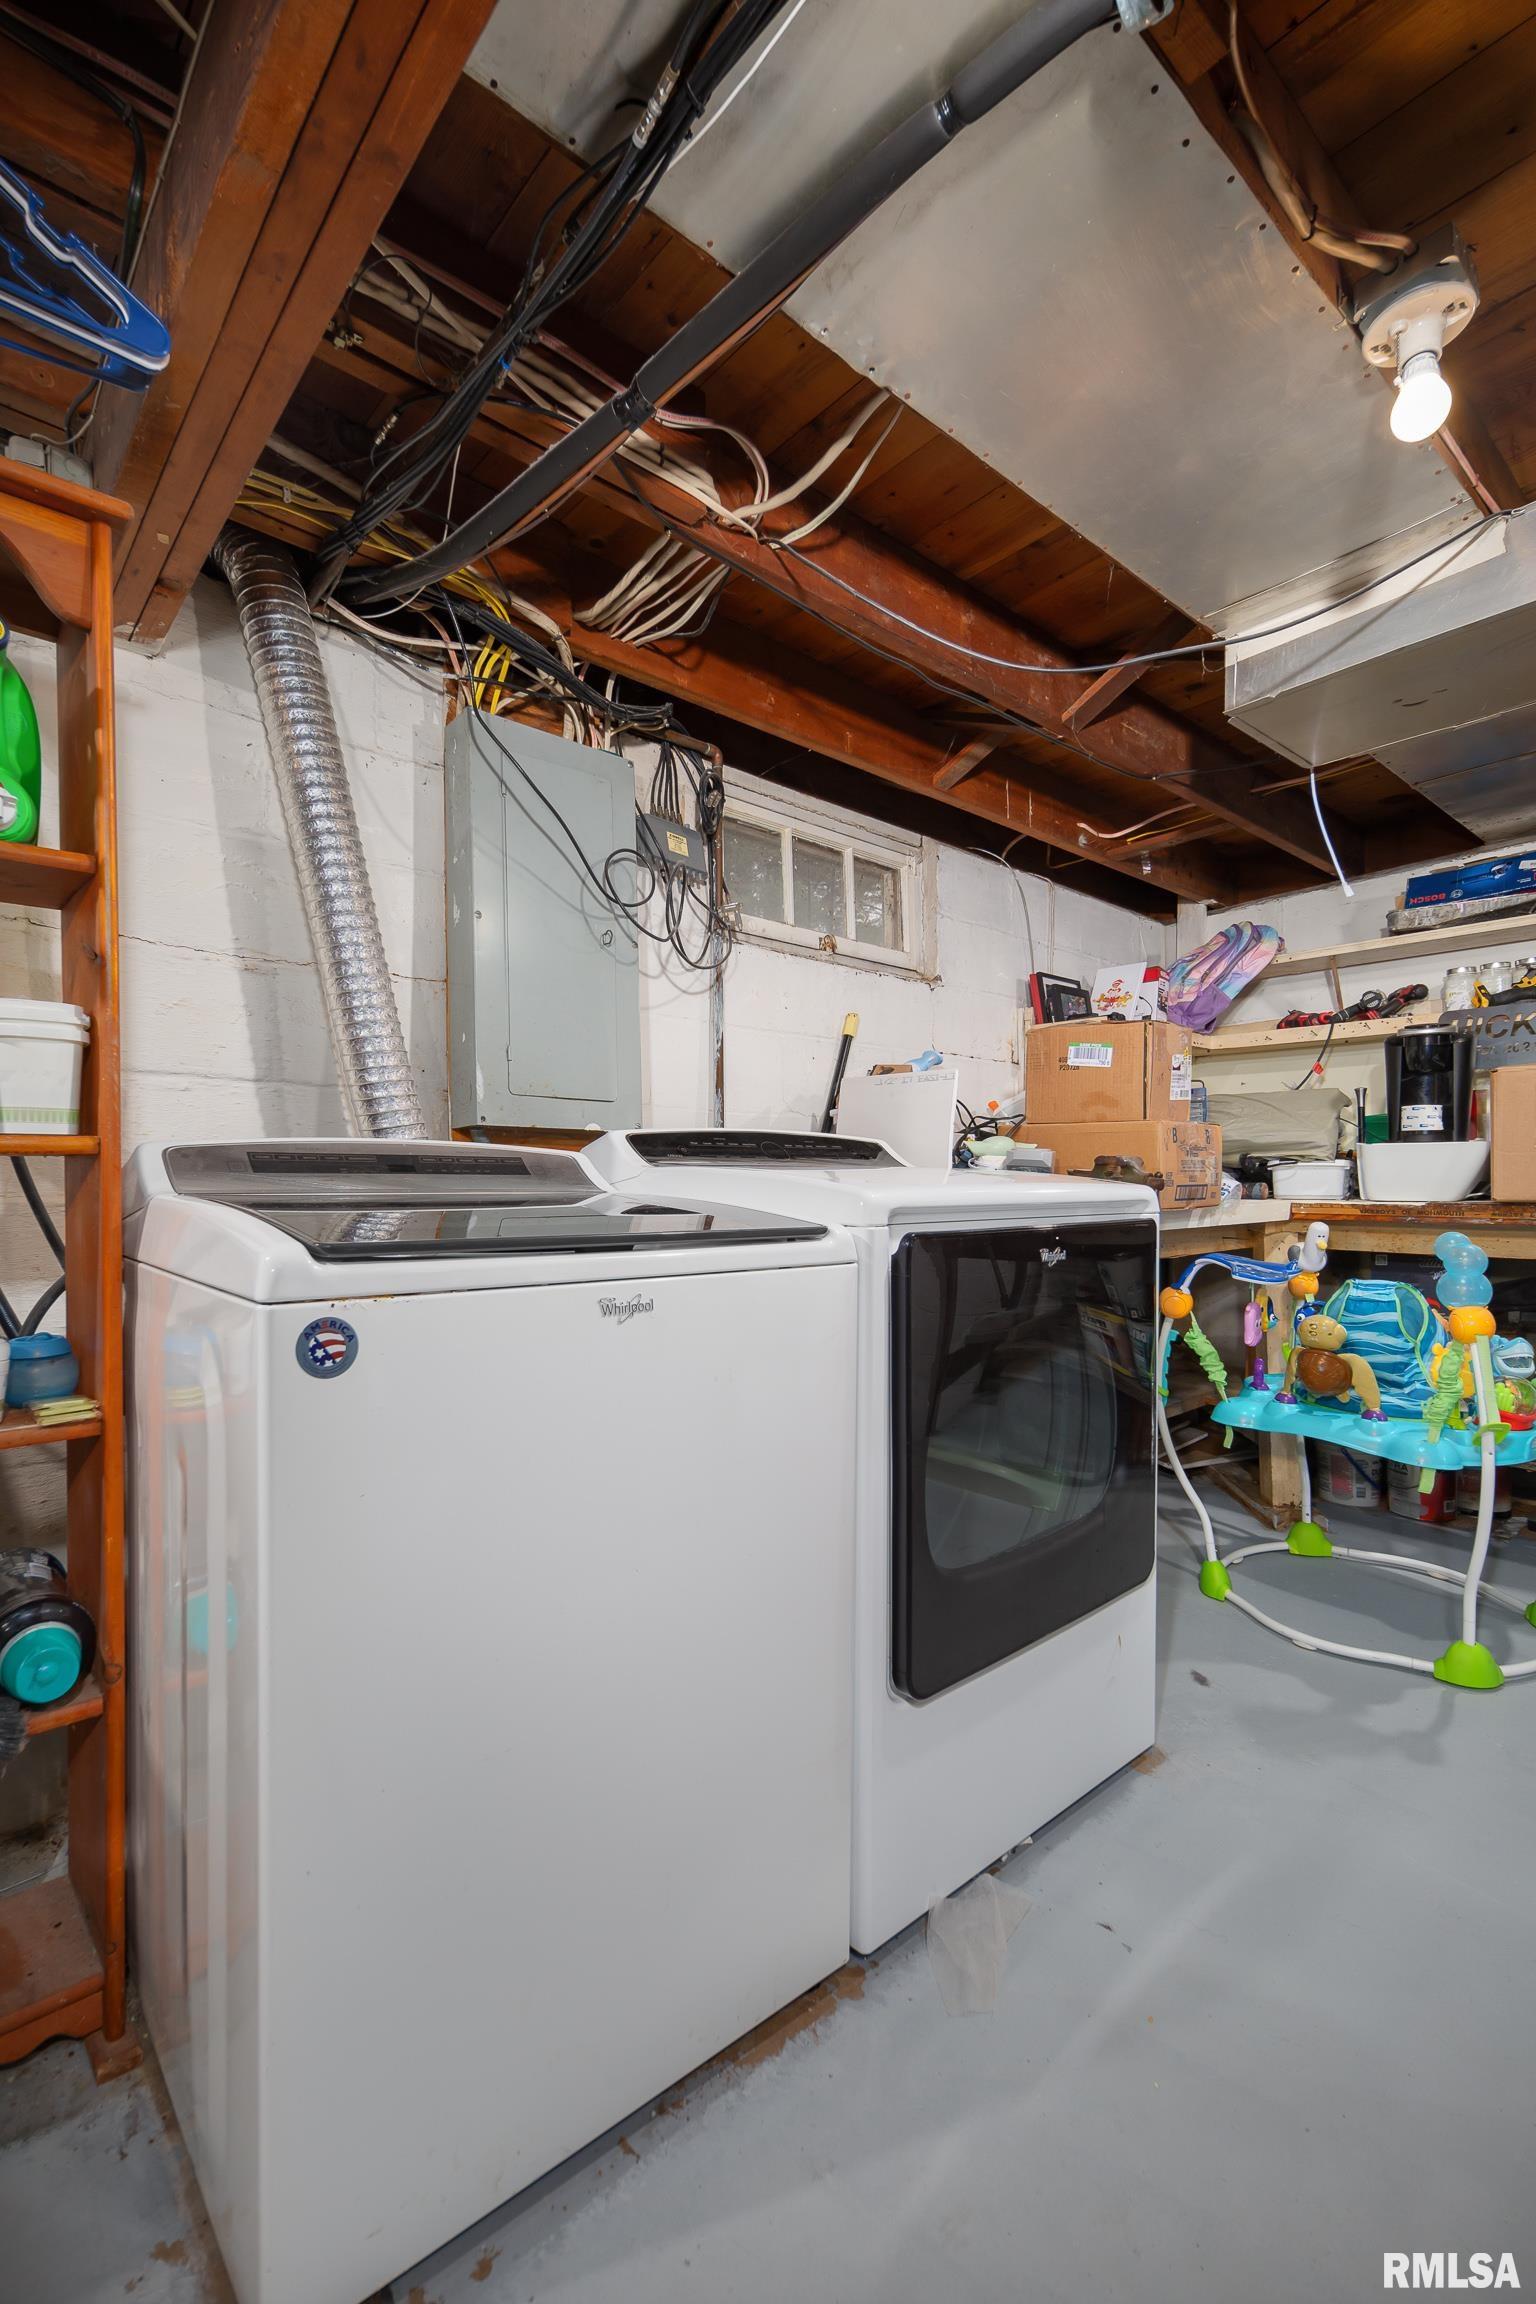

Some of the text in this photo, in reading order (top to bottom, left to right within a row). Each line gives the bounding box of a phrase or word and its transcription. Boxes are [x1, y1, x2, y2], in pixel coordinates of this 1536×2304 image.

[1409, 892, 1447, 905] BOSCH
[599, 1294, 654, 1322] Whirlpool
[303, 1320, 355, 1342] AMERICA
